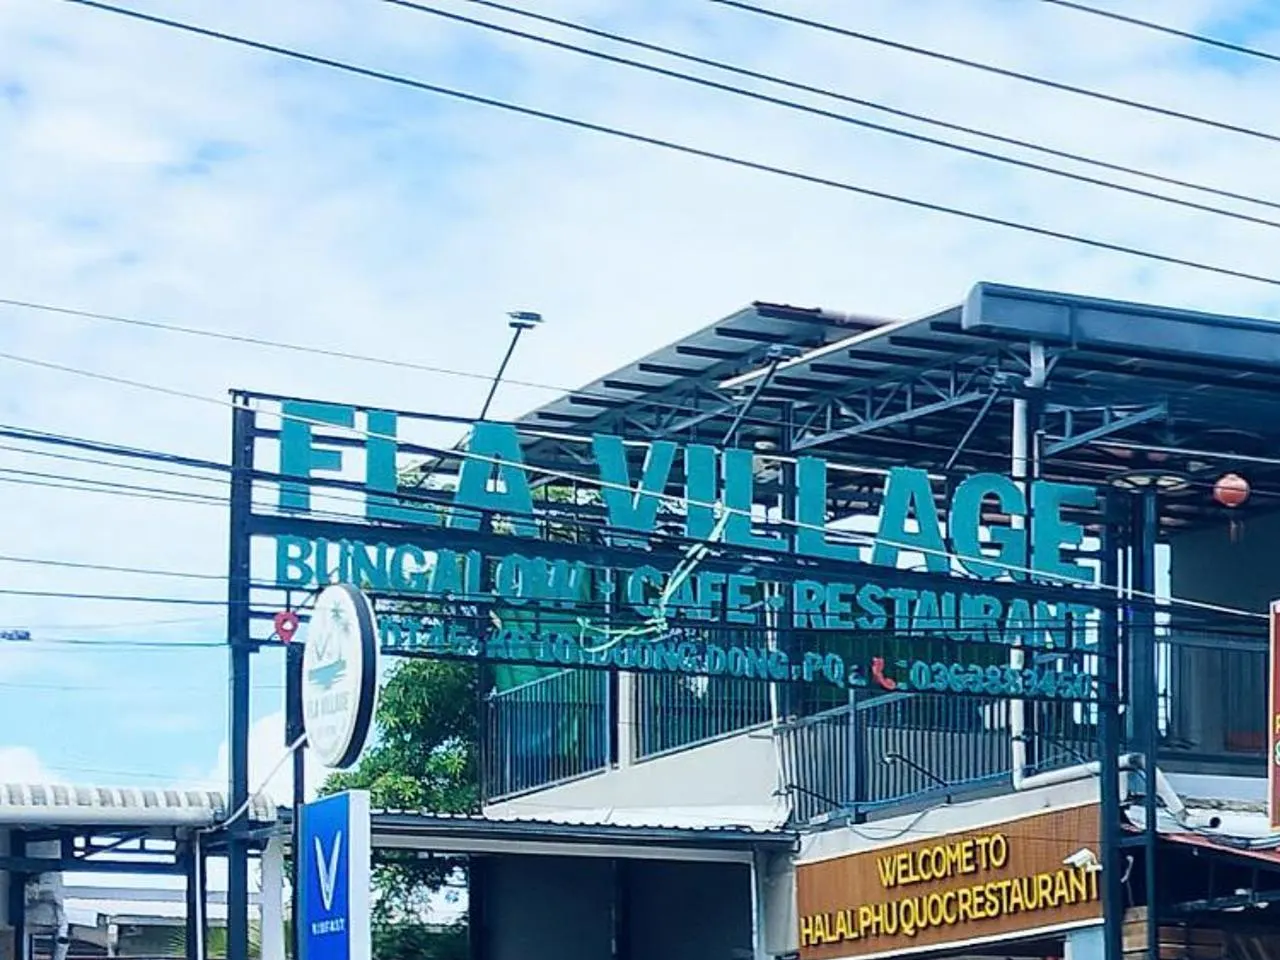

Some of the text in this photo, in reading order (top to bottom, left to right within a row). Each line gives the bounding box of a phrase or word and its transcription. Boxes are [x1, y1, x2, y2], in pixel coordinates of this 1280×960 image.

[592, 432, 1098, 587] VILLAGE
[793, 578, 1097, 650] RESTAURANT
[877, 833, 1008, 888] WELCOME TO
[800, 866, 1100, 946] HALAL PHU QUOC RESTAURANT
